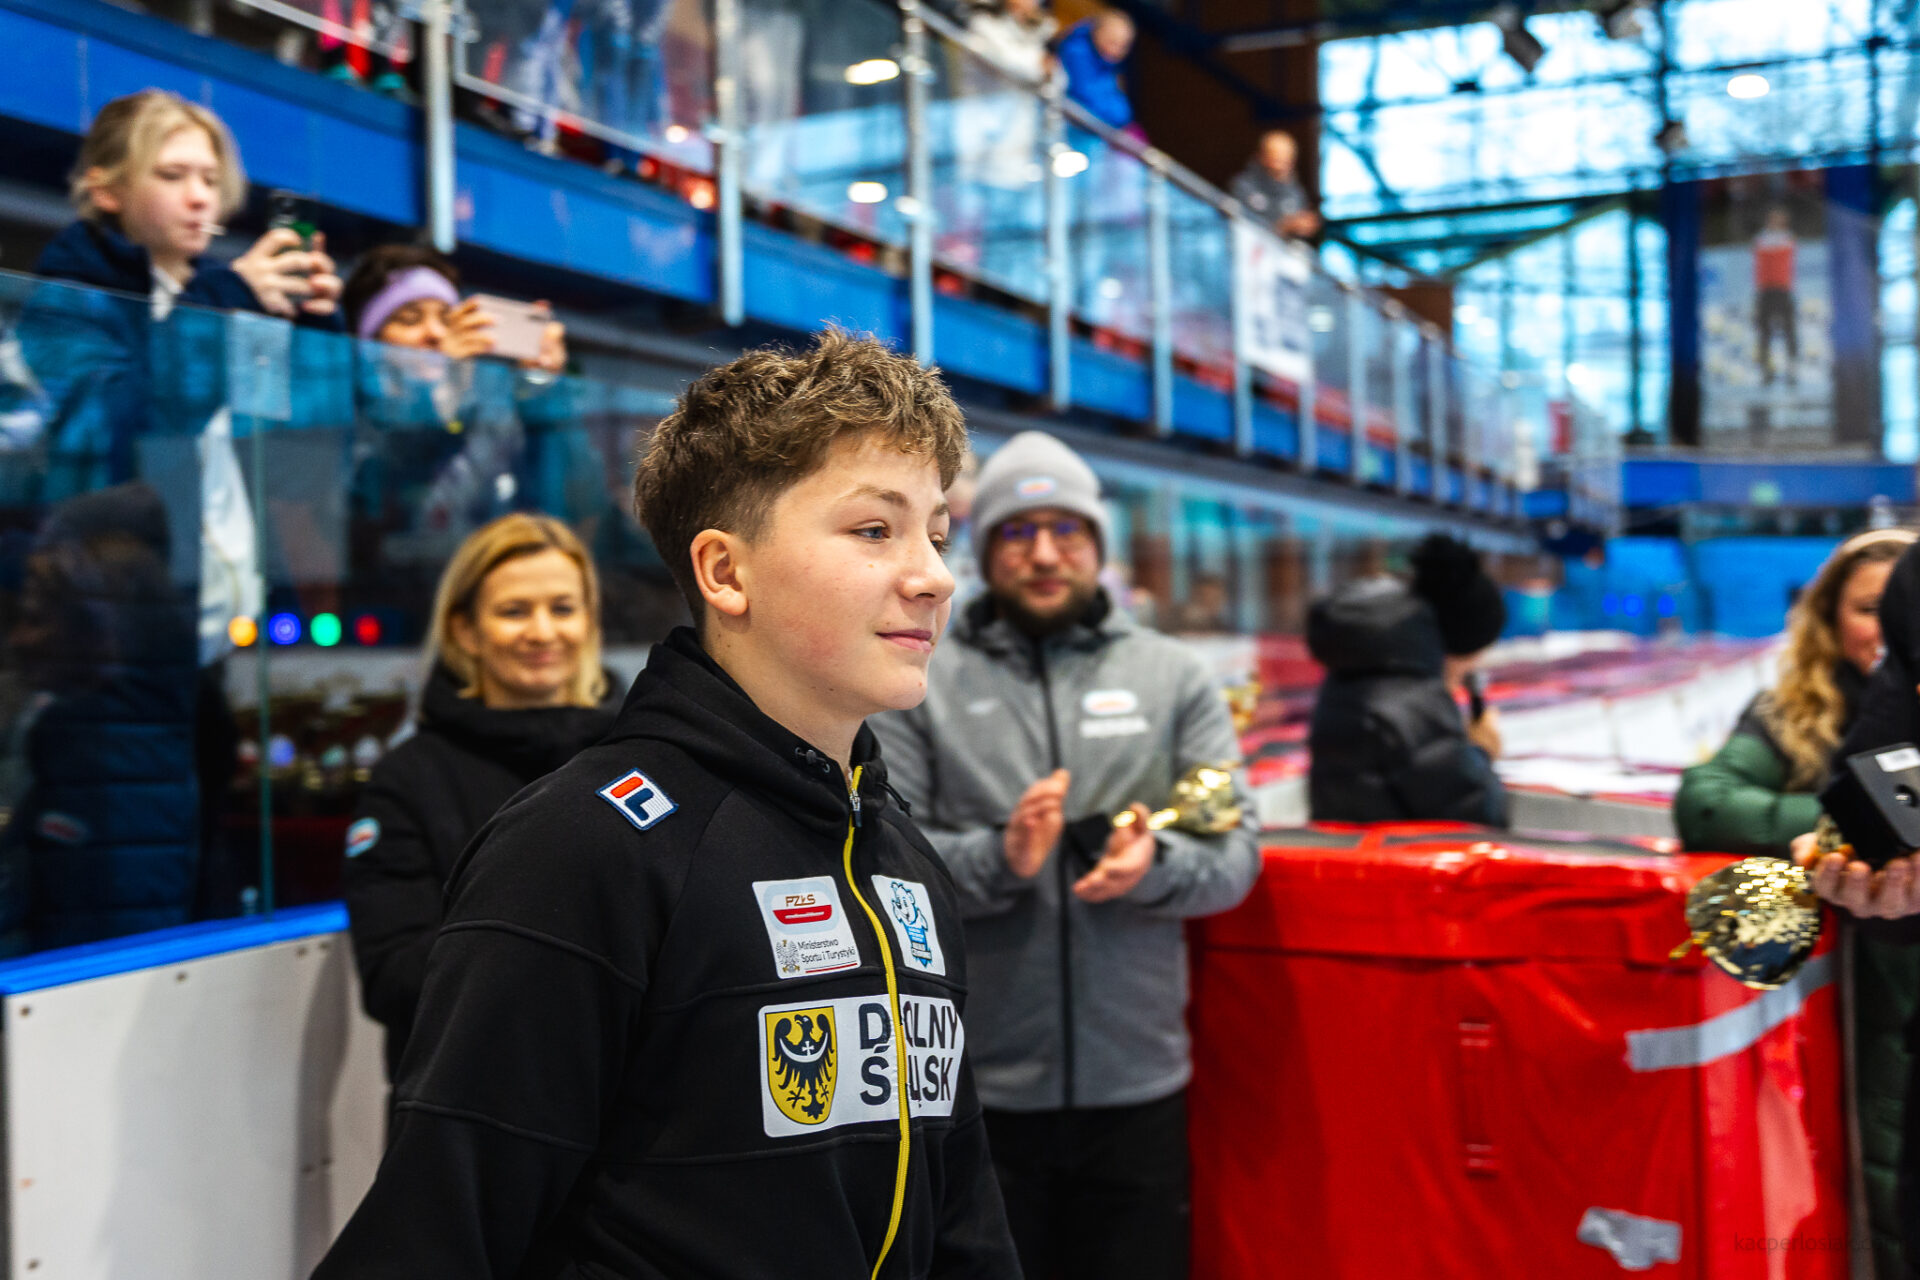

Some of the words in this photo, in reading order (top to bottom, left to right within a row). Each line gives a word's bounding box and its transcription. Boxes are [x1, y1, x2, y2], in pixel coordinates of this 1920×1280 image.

[797, 939, 839, 950] Ministerstwo
[801, 953, 822, 963] Sportu
[825, 946, 856, 961] Turystyki
